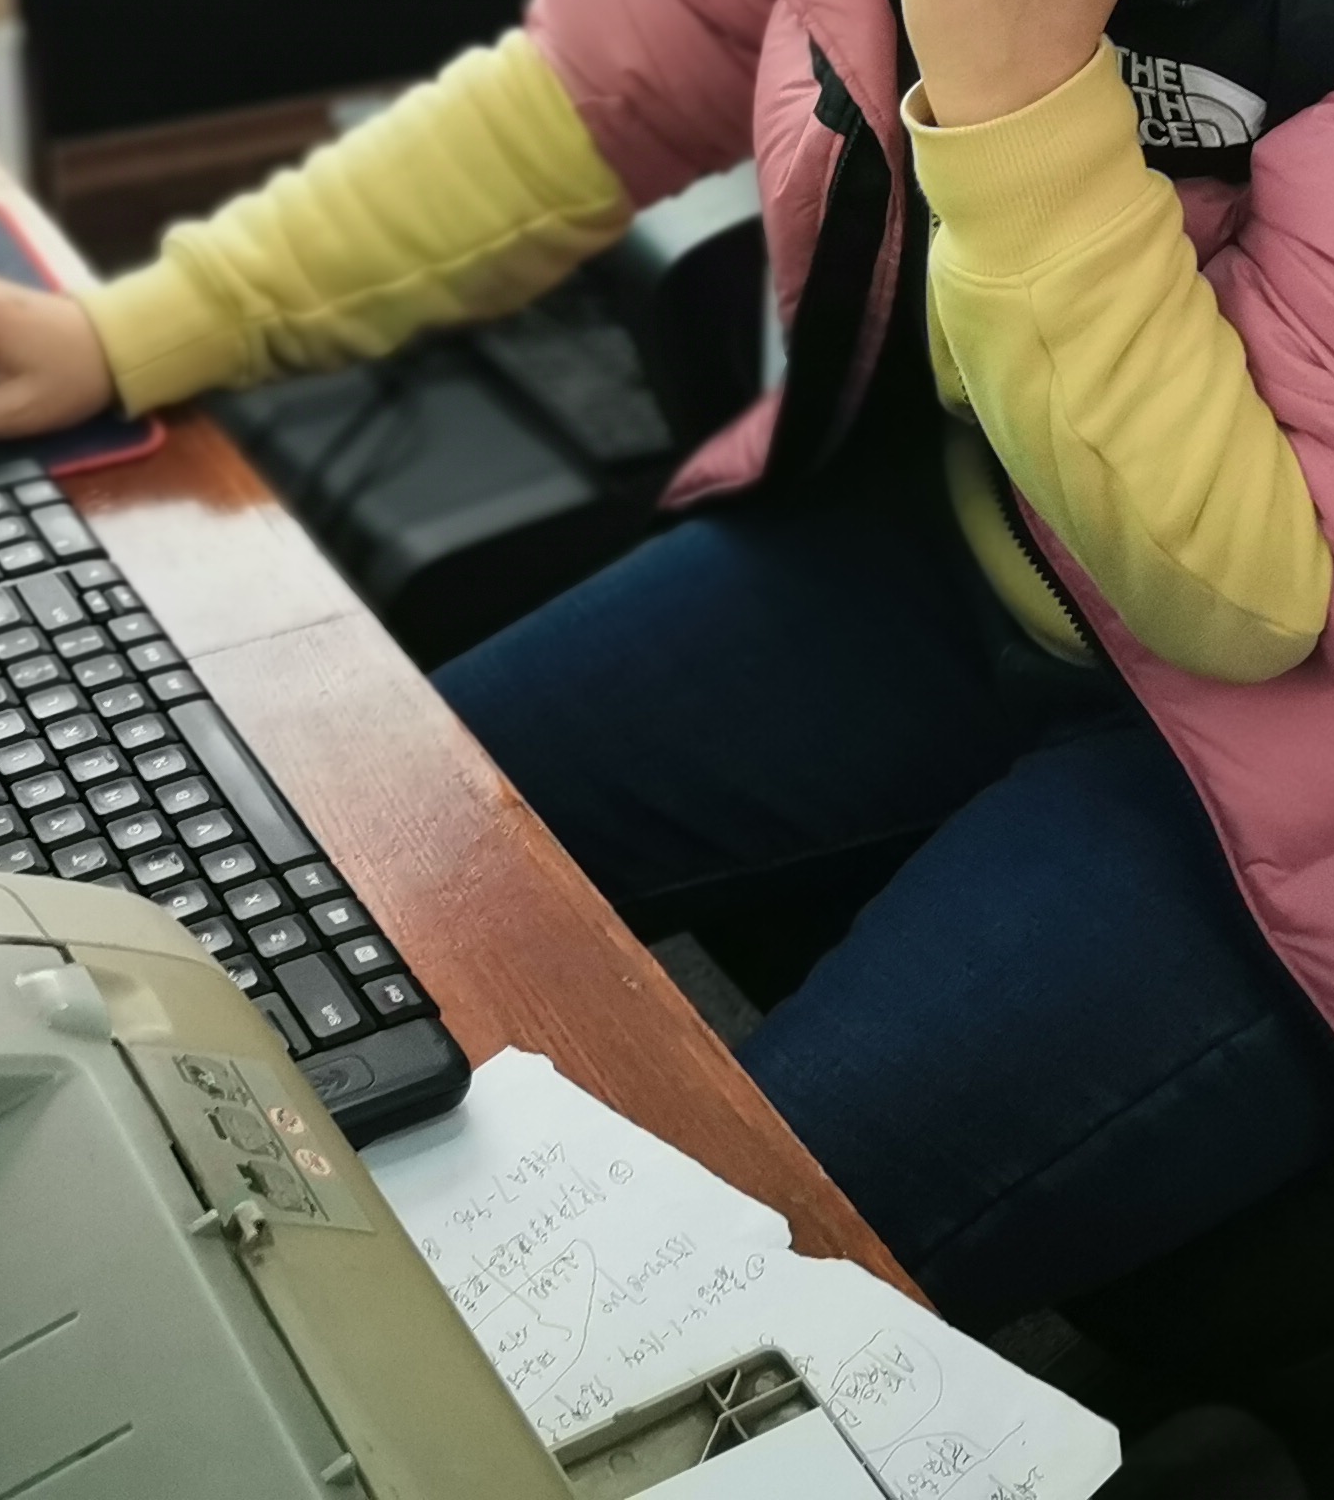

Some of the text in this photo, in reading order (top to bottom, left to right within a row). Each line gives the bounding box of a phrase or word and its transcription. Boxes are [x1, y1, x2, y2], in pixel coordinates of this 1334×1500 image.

[1115, 46, 1181, 93] THE
[1132, 85, 1191, 122] TH
[1139, 116, 1199, 148] CE
